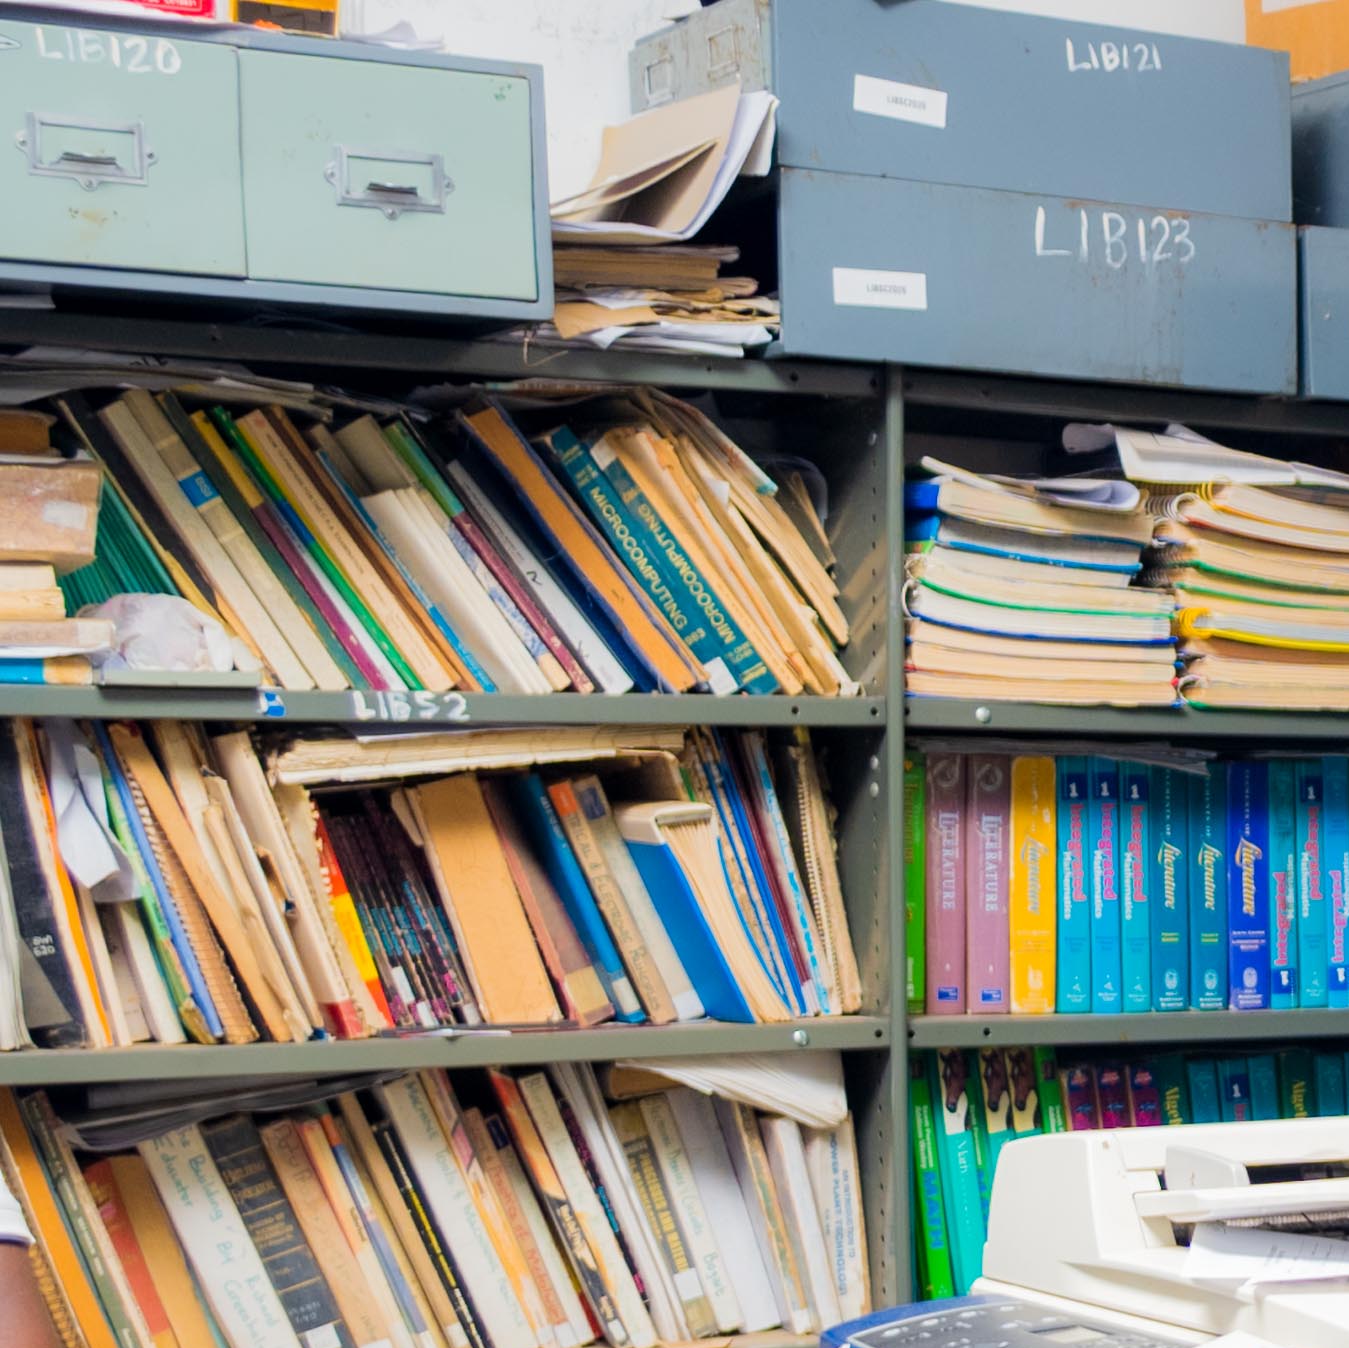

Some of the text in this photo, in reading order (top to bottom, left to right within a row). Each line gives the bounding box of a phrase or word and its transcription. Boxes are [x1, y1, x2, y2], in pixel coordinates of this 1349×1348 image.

[35, 26, 182, 75] LIB120
[1066, 37, 1162, 72] LIB121
[1035, 205, 1195, 269] LIB123
[590, 486, 687, 630] MICROCOMPUTING
[637, 503, 737, 645] MICROCOMPUTING
[567, 811, 590, 859] TRICAL
[1067, 803, 1087, 902] Integrated
[1098, 803, 1117, 901] Integrated
[1128, 804, 1147, 902] Integrated
[1305, 806, 1323, 900] Integrated
[1157, 840, 1183, 910] Literature
[1198, 841, 1223, 911] Literature
[1235, 836, 1263, 916] Literature
[657, 1209, 673, 1233] AND
[666, 1231, 690, 1273] MATERI
[923, 1171, 945, 1249] MATH
